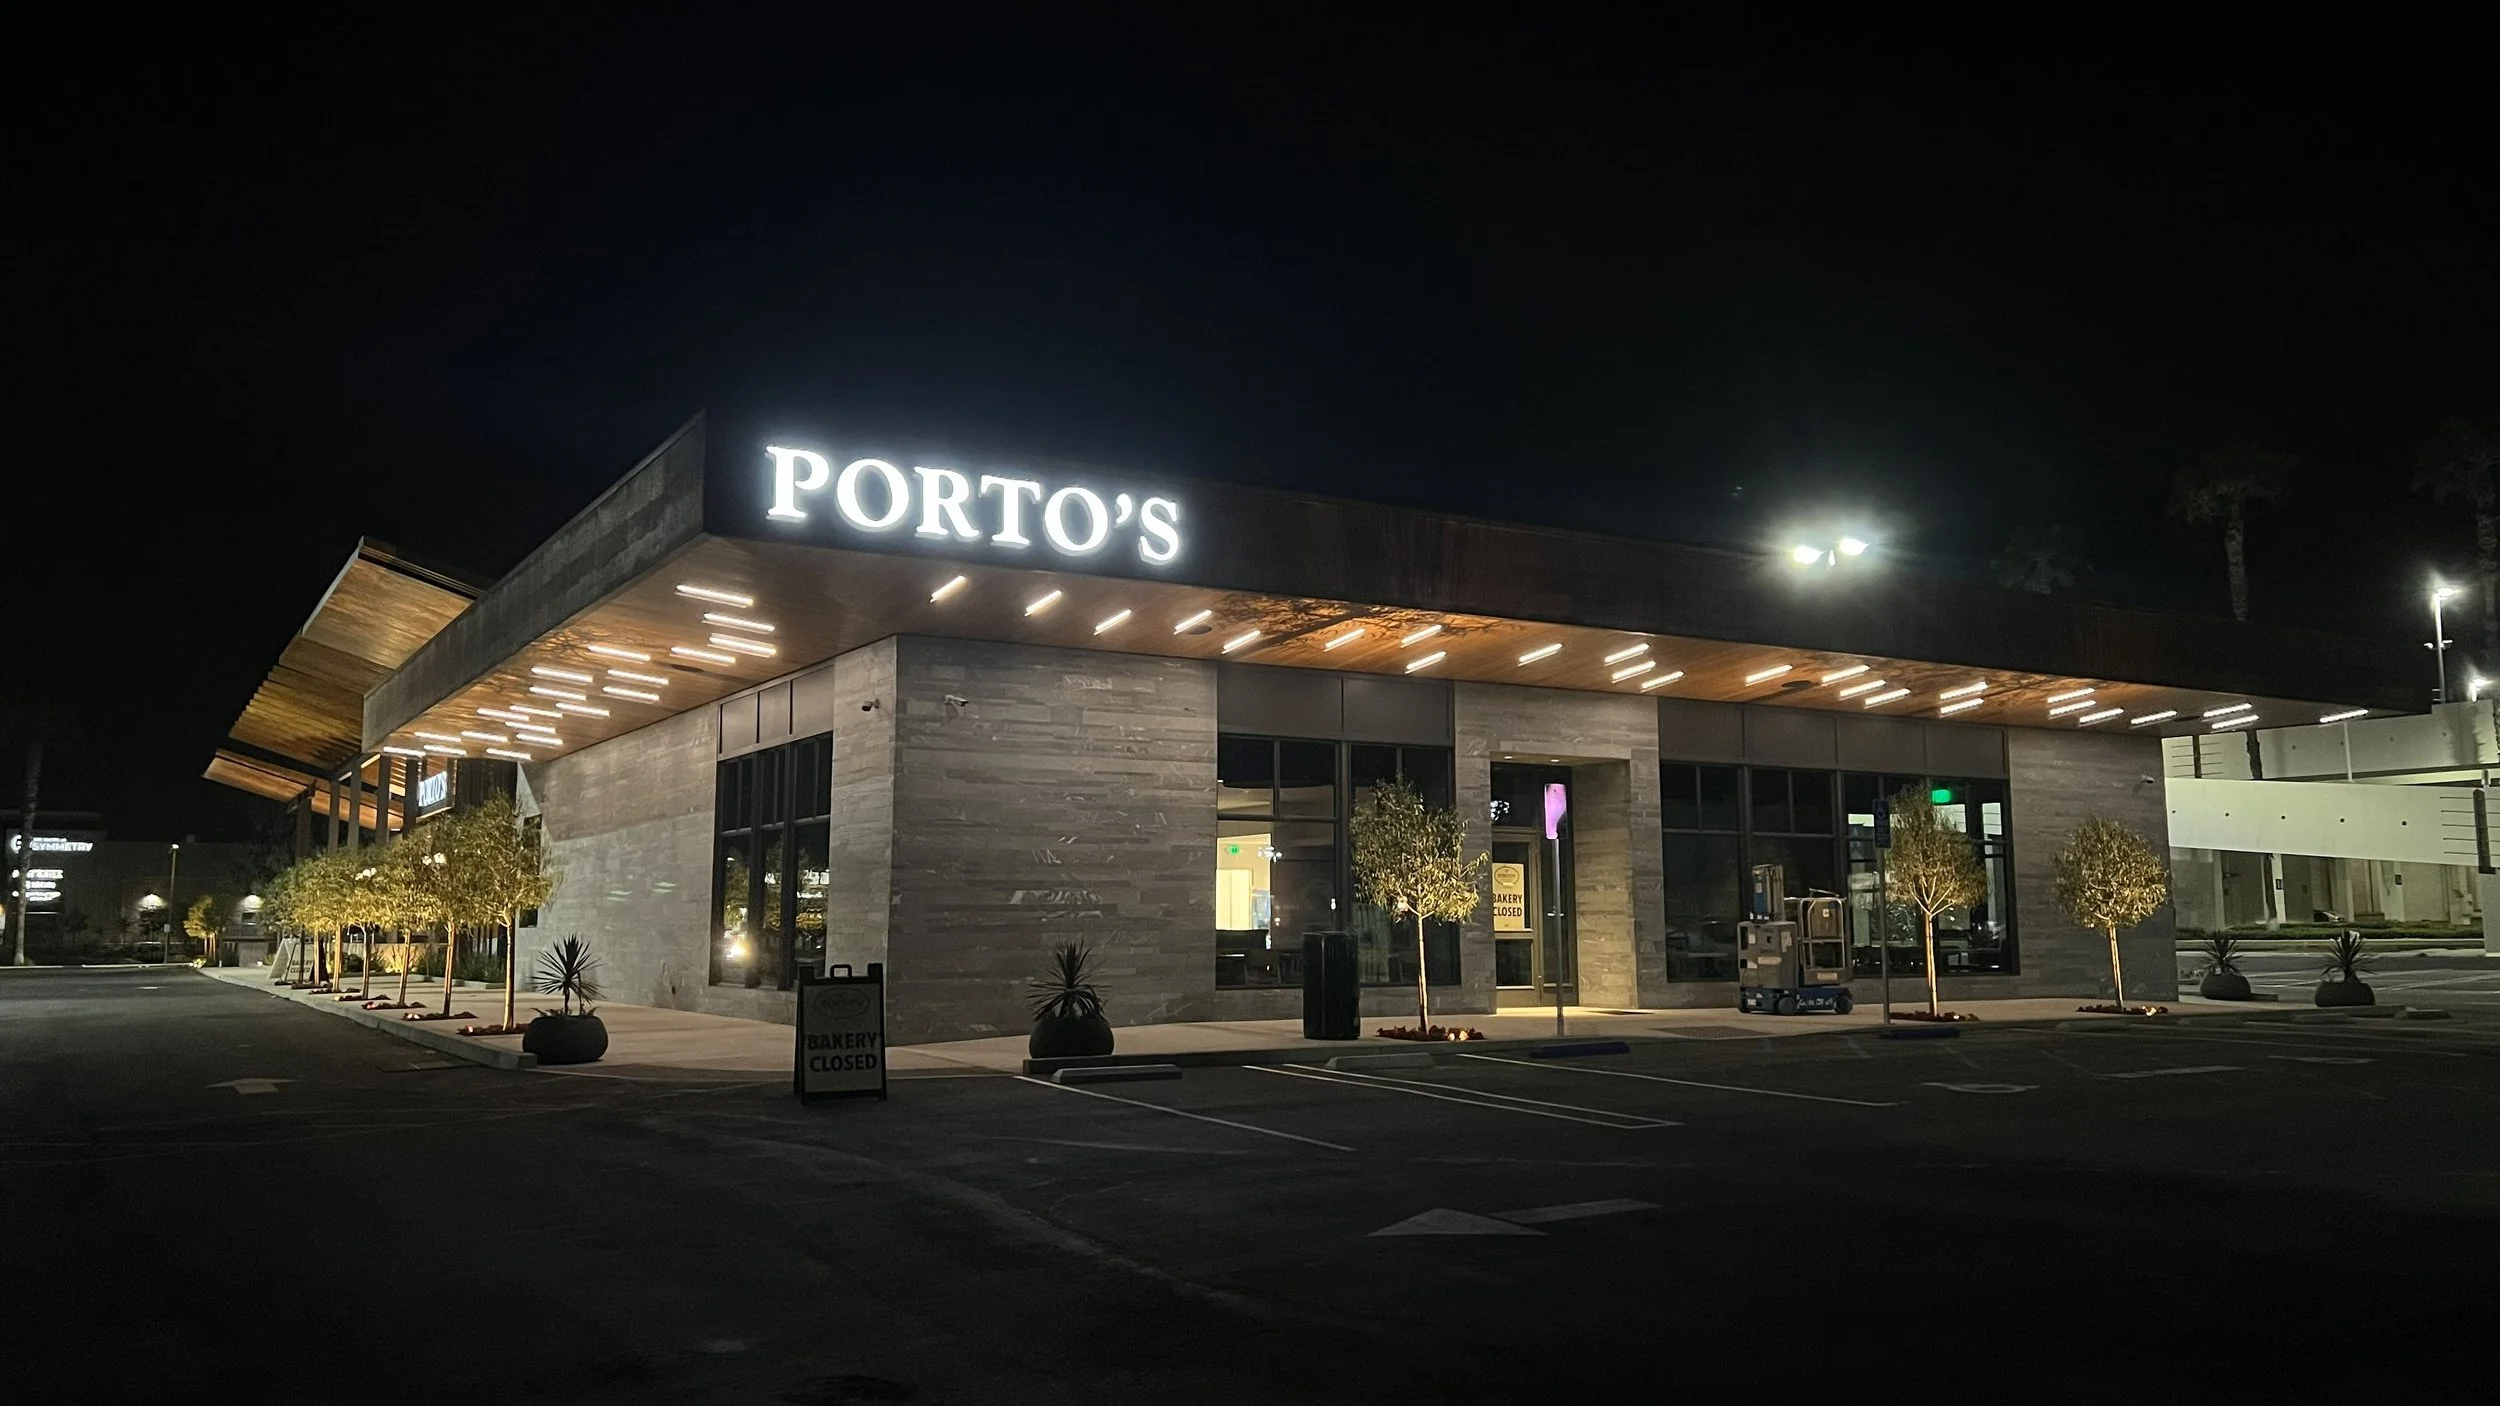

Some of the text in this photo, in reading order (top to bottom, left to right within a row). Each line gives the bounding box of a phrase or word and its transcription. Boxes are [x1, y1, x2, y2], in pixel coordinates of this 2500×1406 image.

[765, 445, 1179, 565] PORTO'S
[32, 842, 93, 851] SYMMETRY
[1493, 906, 1523, 917] CLOSED
[806, 1032, 877, 1050] BAKERY
[809, 1054, 878, 1072] CLOSED
